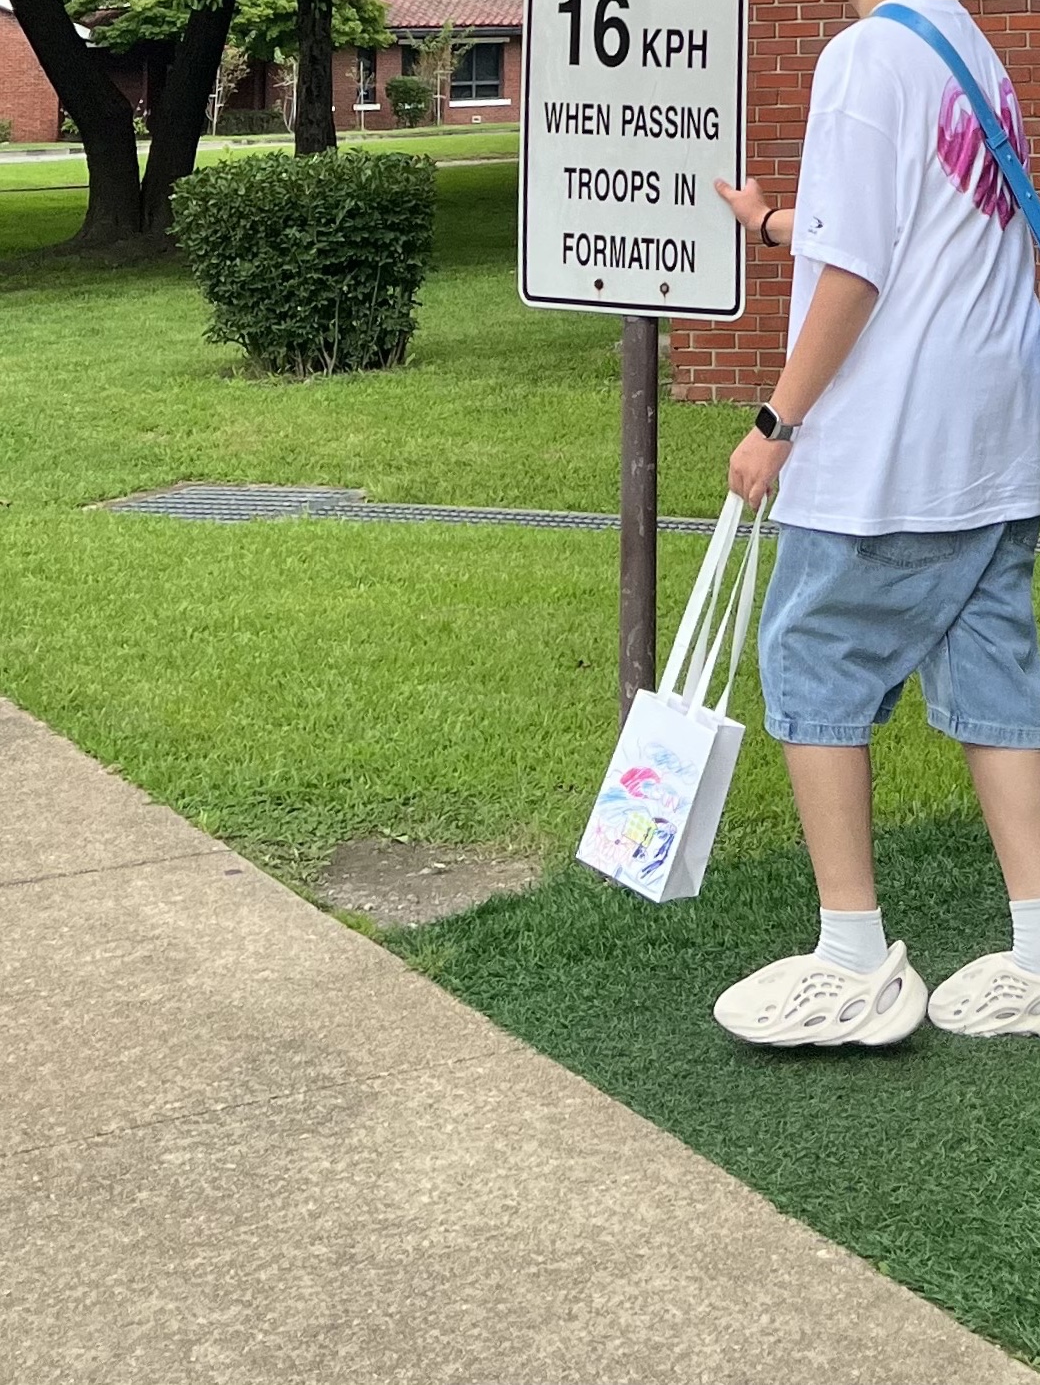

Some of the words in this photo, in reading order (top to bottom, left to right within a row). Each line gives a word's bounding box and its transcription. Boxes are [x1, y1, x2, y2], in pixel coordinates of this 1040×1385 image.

[642, 28, 708, 69] KPH
[544, 101, 611, 136] WHEN
[621, 104, 719, 141] PASSING
[563, 167, 661, 205] TROOPS
[674, 172, 696, 206] IN
[562, 232, 696, 273] FORMATION
